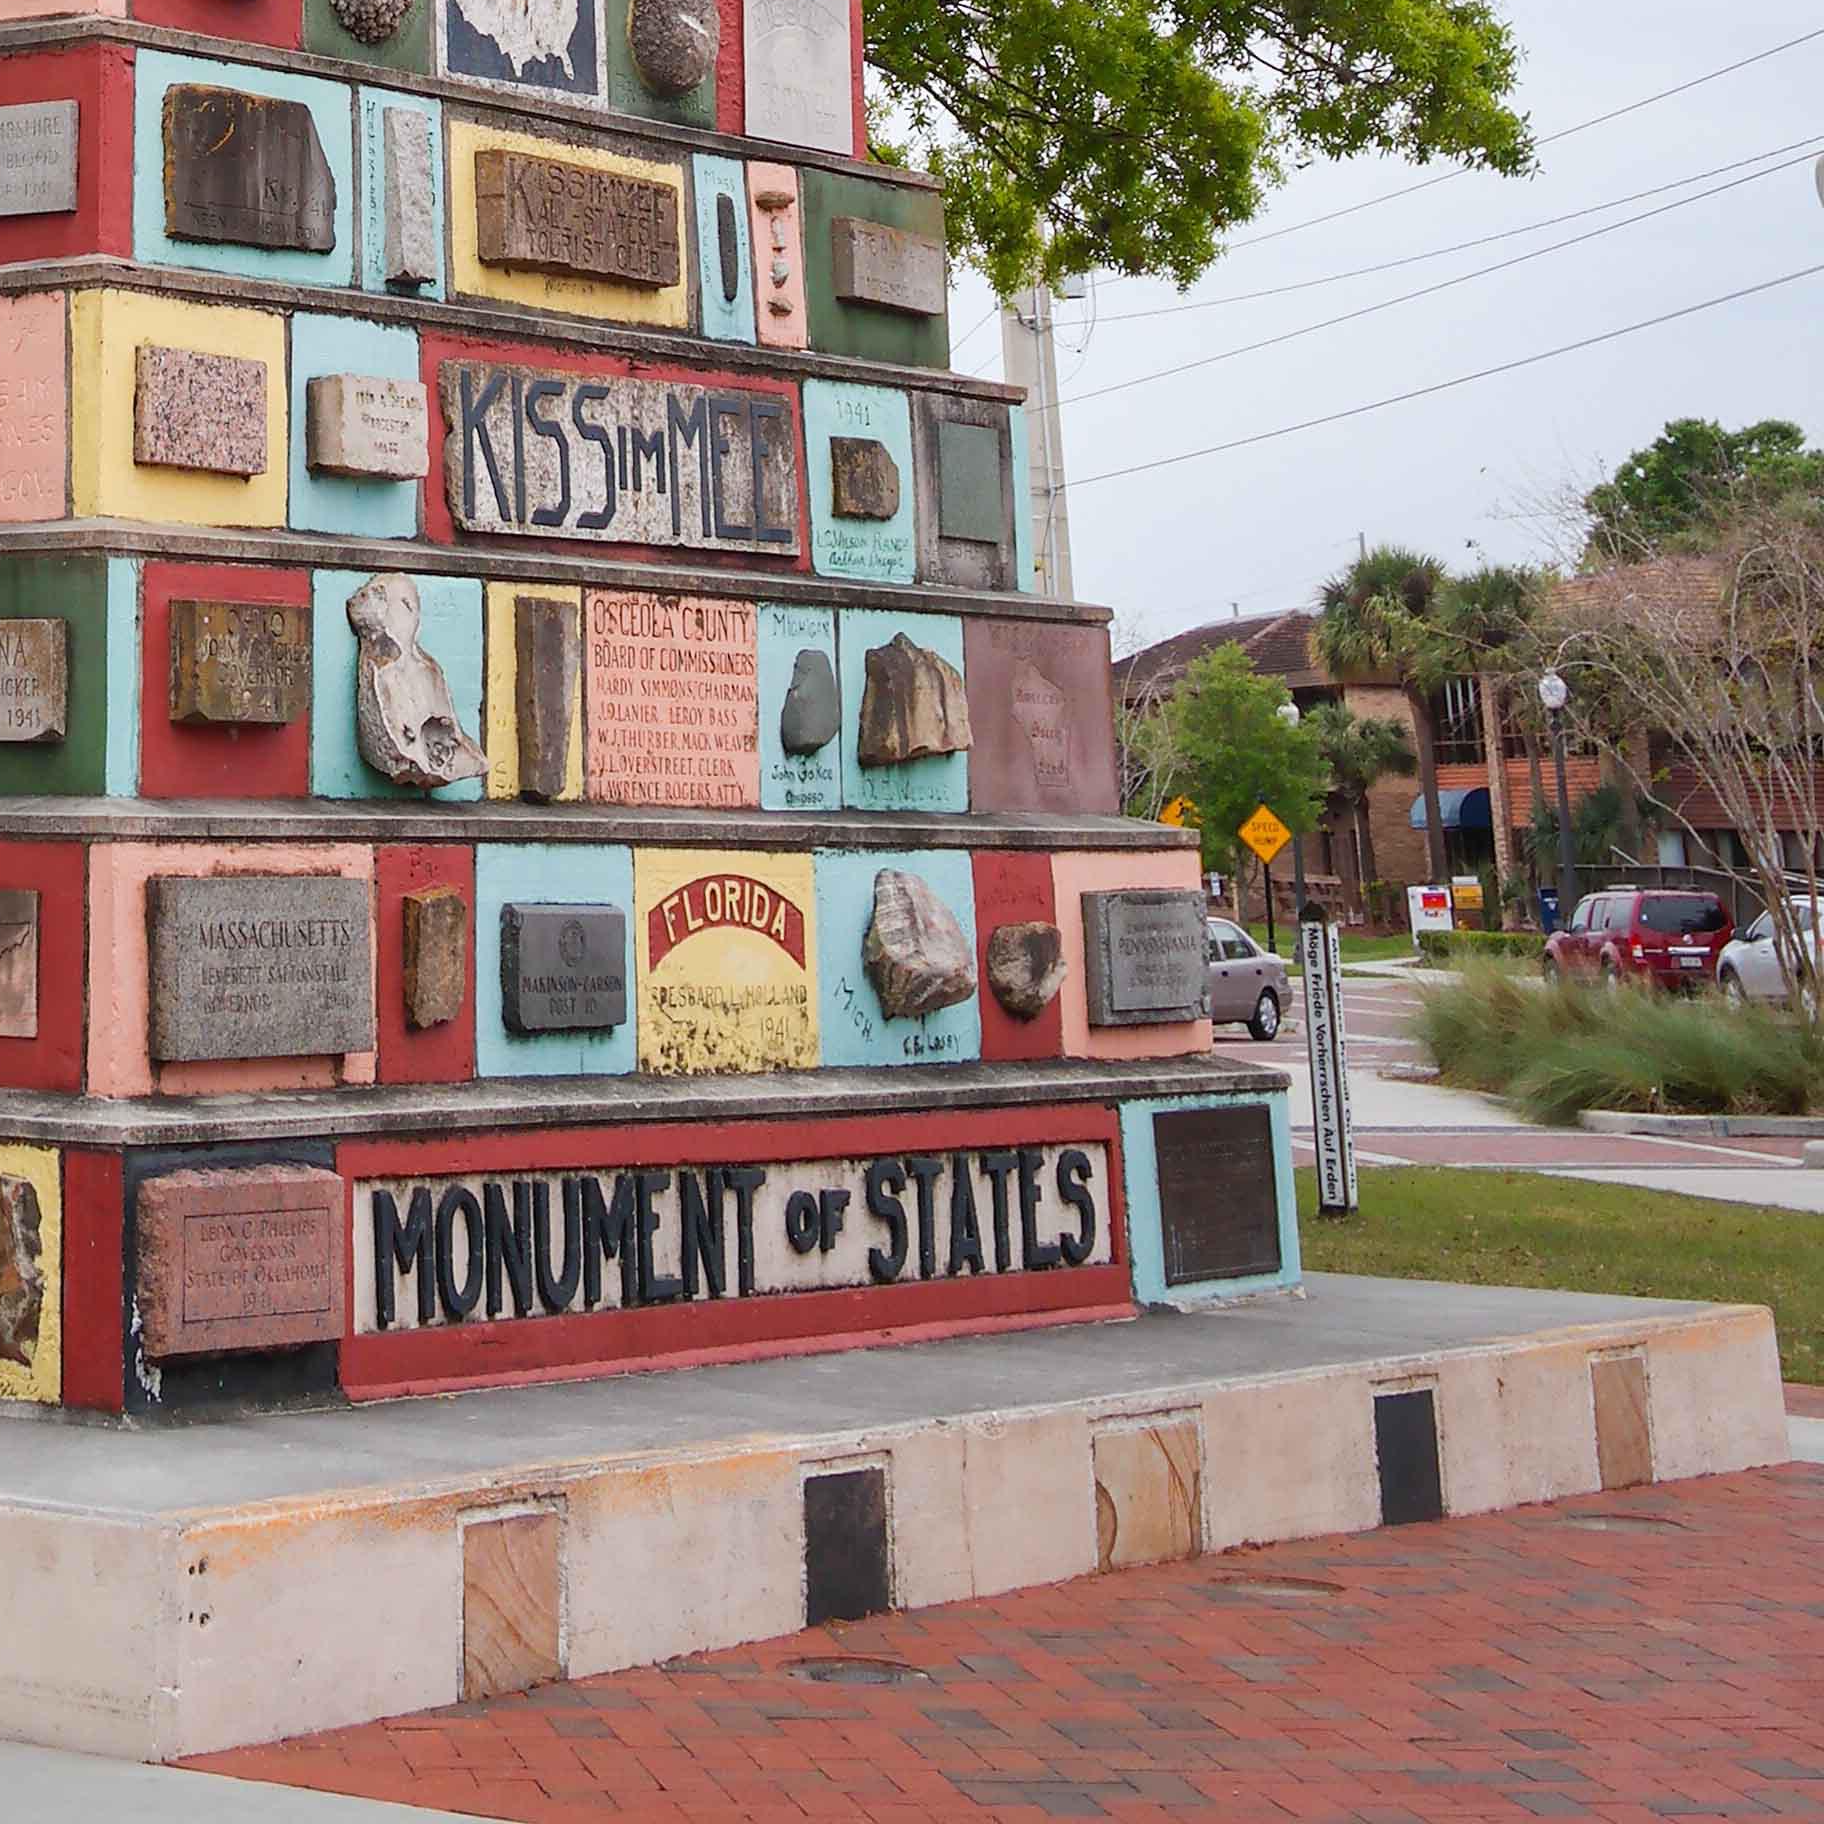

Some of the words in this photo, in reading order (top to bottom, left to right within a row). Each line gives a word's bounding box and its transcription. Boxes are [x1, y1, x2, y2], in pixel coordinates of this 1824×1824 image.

[6, 148, 58, 170] BLOOD
[508, 157, 675, 250] KISSIMMEE
[526, 229, 605, 264] TOURIST
[616, 244, 661, 277] CLUB
[835, 400, 873, 427] 1941
[459, 369, 792, 542] KISSIMMEE
[227, 609, 286, 639] OHIO
[593, 599, 674, 640] OSCEOLA
[682, 606, 751, 644] COUNTY
[593, 641, 636, 670] BOARD
[639, 647, 657, 670] OF
[659, 648, 756, 676] COMMISSIONERS
[217, 665, 296, 689] GOVERNOR
[596, 675, 634, 697] HARDY
[698, 680, 755, 702] CHAIRMAN
[6, 707, 42, 729] 1941
[668, 706, 704, 726] LEROY
[708, 707, 738, 727] BASS
[681, 732, 711, 751] MACK
[714, 733, 757, 753] WEAVER
[698, 757, 736, 777] CLERK
[597, 778, 661, 801] LAWRENCE
[662, 879, 788, 944] FLORIDA
[198, 918, 351, 953] MASSACHUSETTS
[1117, 934, 1197, 954] PENNSYLVANIA
[1306, 926, 1321, 970] Möge
[200, 964, 264, 988] LEVERETT
[266, 962, 349, 986] SALTONSTALL
[520, 974, 624, 995] MAKINSON-CARSON
[549, 997, 578, 1017] POST
[744, 984, 808, 1006] HOLLAND
[1312, 971, 1323, 1019] Friede
[759, 1016, 791, 1039] 1941
[1315, 1022, 1330, 1124] Vorherrschen
[1322, 1126, 1335, 1157] Auf
[1325, 1158, 1338, 1202] Erden
[200, 1223, 235, 1242] LEON
[259, 1218, 317, 1239] PHILLIPS
[374, 1167, 767, 1332] MONUMENT
[785, 1188, 852, 1255] OF
[864, 1149, 1097, 1286] STATES
[219, 1241, 297, 1263] GOVERNOR
[185, 1269, 229, 1289] STATE
[232, 1269, 248, 1287] OF
[254, 1263, 329, 1284] OKLAHOMA
